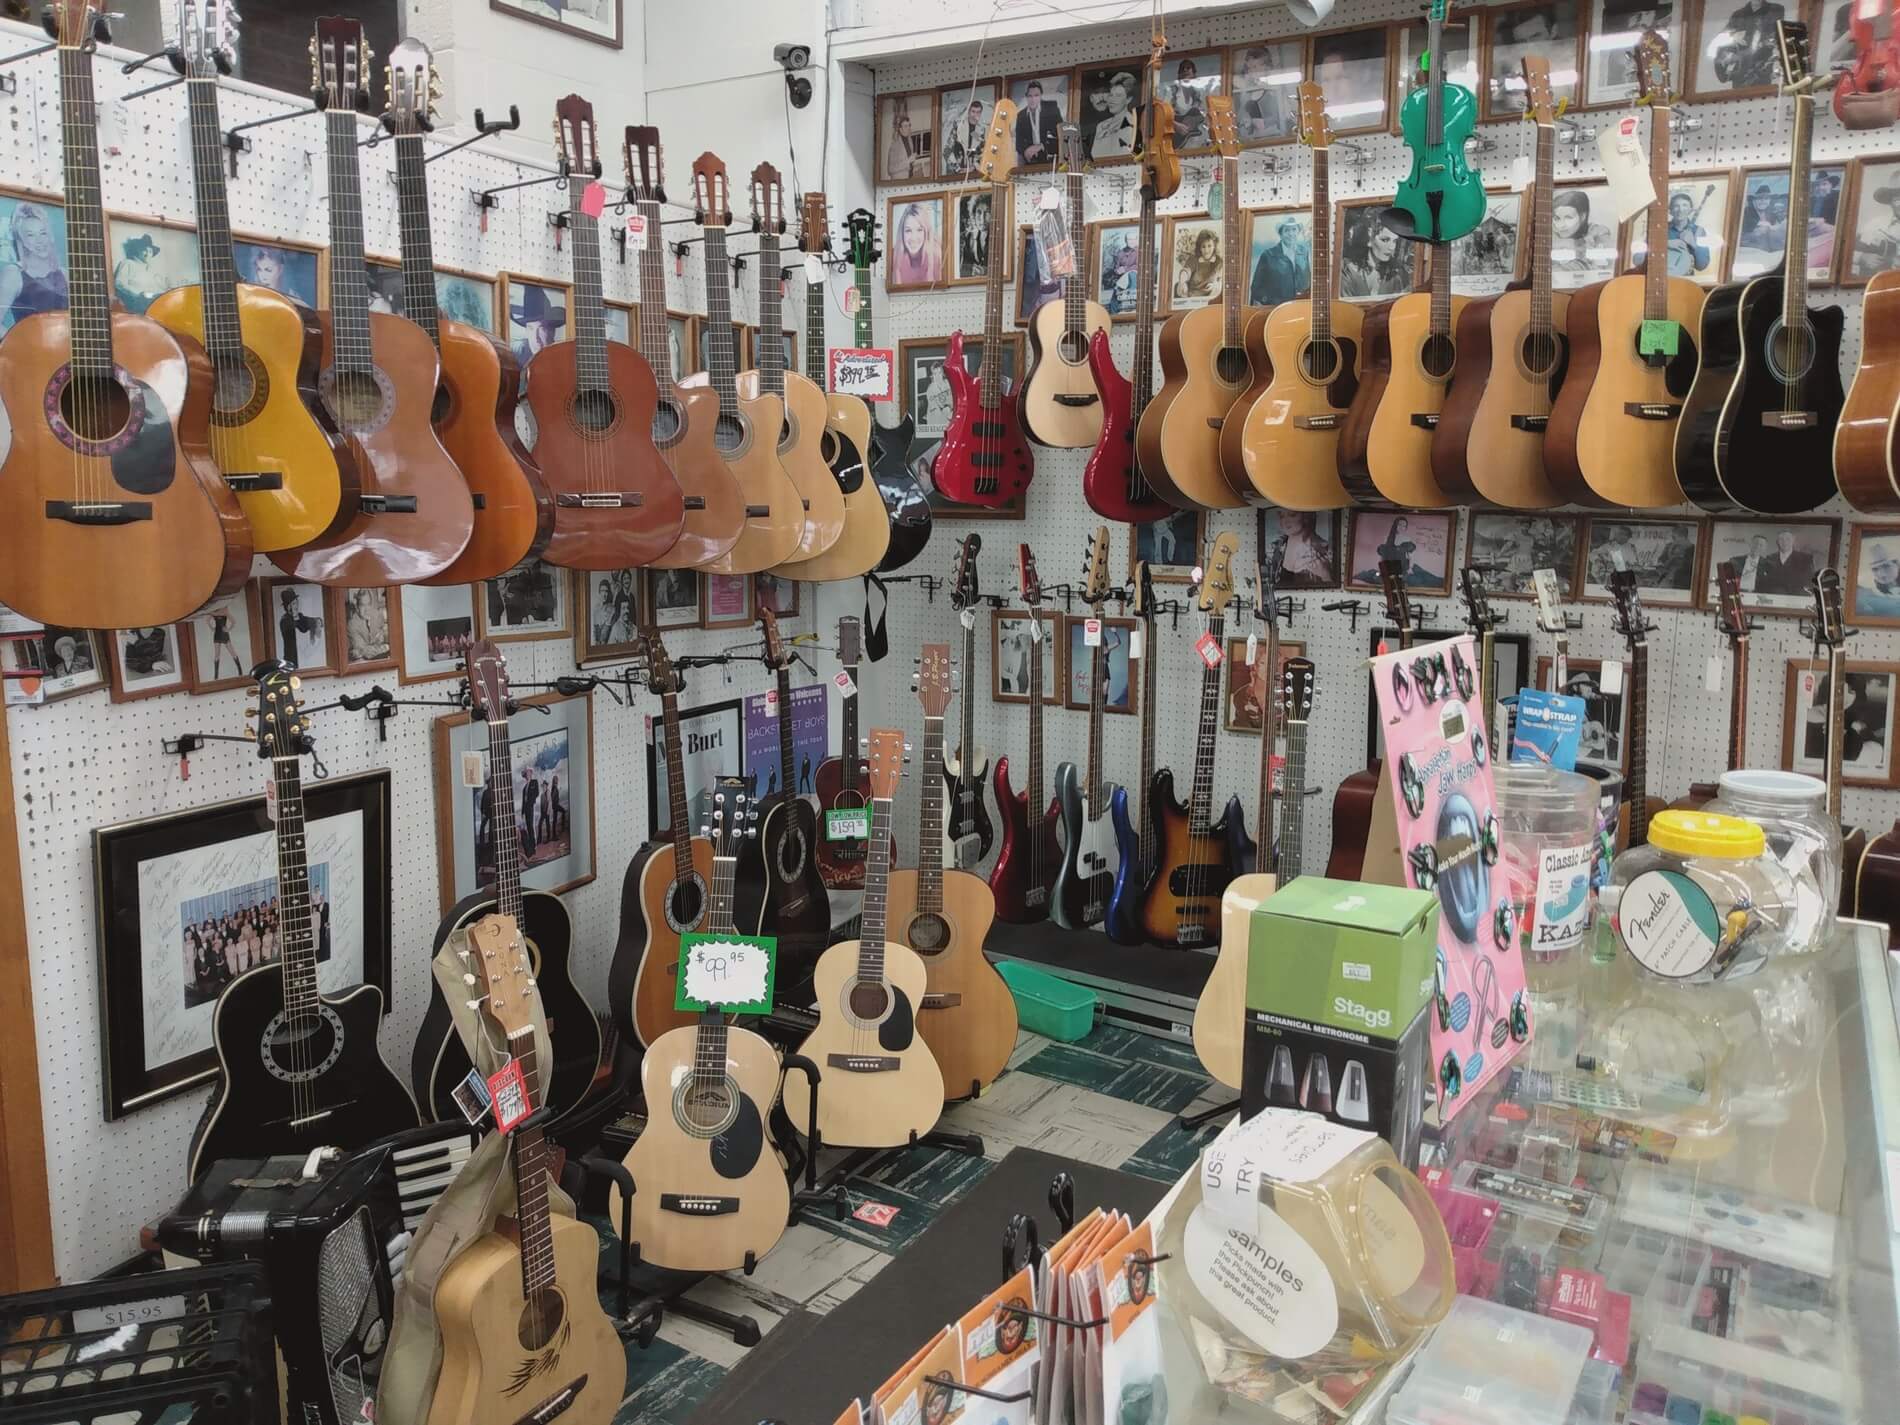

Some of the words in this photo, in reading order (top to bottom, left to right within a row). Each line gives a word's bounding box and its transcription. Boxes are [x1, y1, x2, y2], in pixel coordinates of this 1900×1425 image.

[748, 718, 802, 740] BACKSTET
[804, 714, 826, 728] BOYS
[830, 821, 855, 834] $159
[1545, 849, 1580, 873] Classic
[1629, 890, 1671, 941] Fender
[1660, 939, 1677, 961] PATCH
[1256, 1012, 1313, 1032] MECHANICAL
[1312, 1024, 1370, 1044] METRONOME
[1333, 996, 1391, 1028] Stagg
[1236, 1157, 1256, 1195] TRY
[1208, 1266, 1224, 1282] this
[1223, 1279, 1246, 1300] great
[1217, 1249, 1232, 1263] the
[1231, 1260, 1275, 1300] Pickpunch!
[1223, 1240, 1244, 1261] Picks
[1244, 1260, 1267, 1281] made
[1267, 1278, 1285, 1296] with
[1213, 1257, 1241, 1284] Please
[1240, 1282, 1256, 1297] ask
[1255, 1294, 1280, 1316] about
[105, 1305, 162, 1326] $15.95
